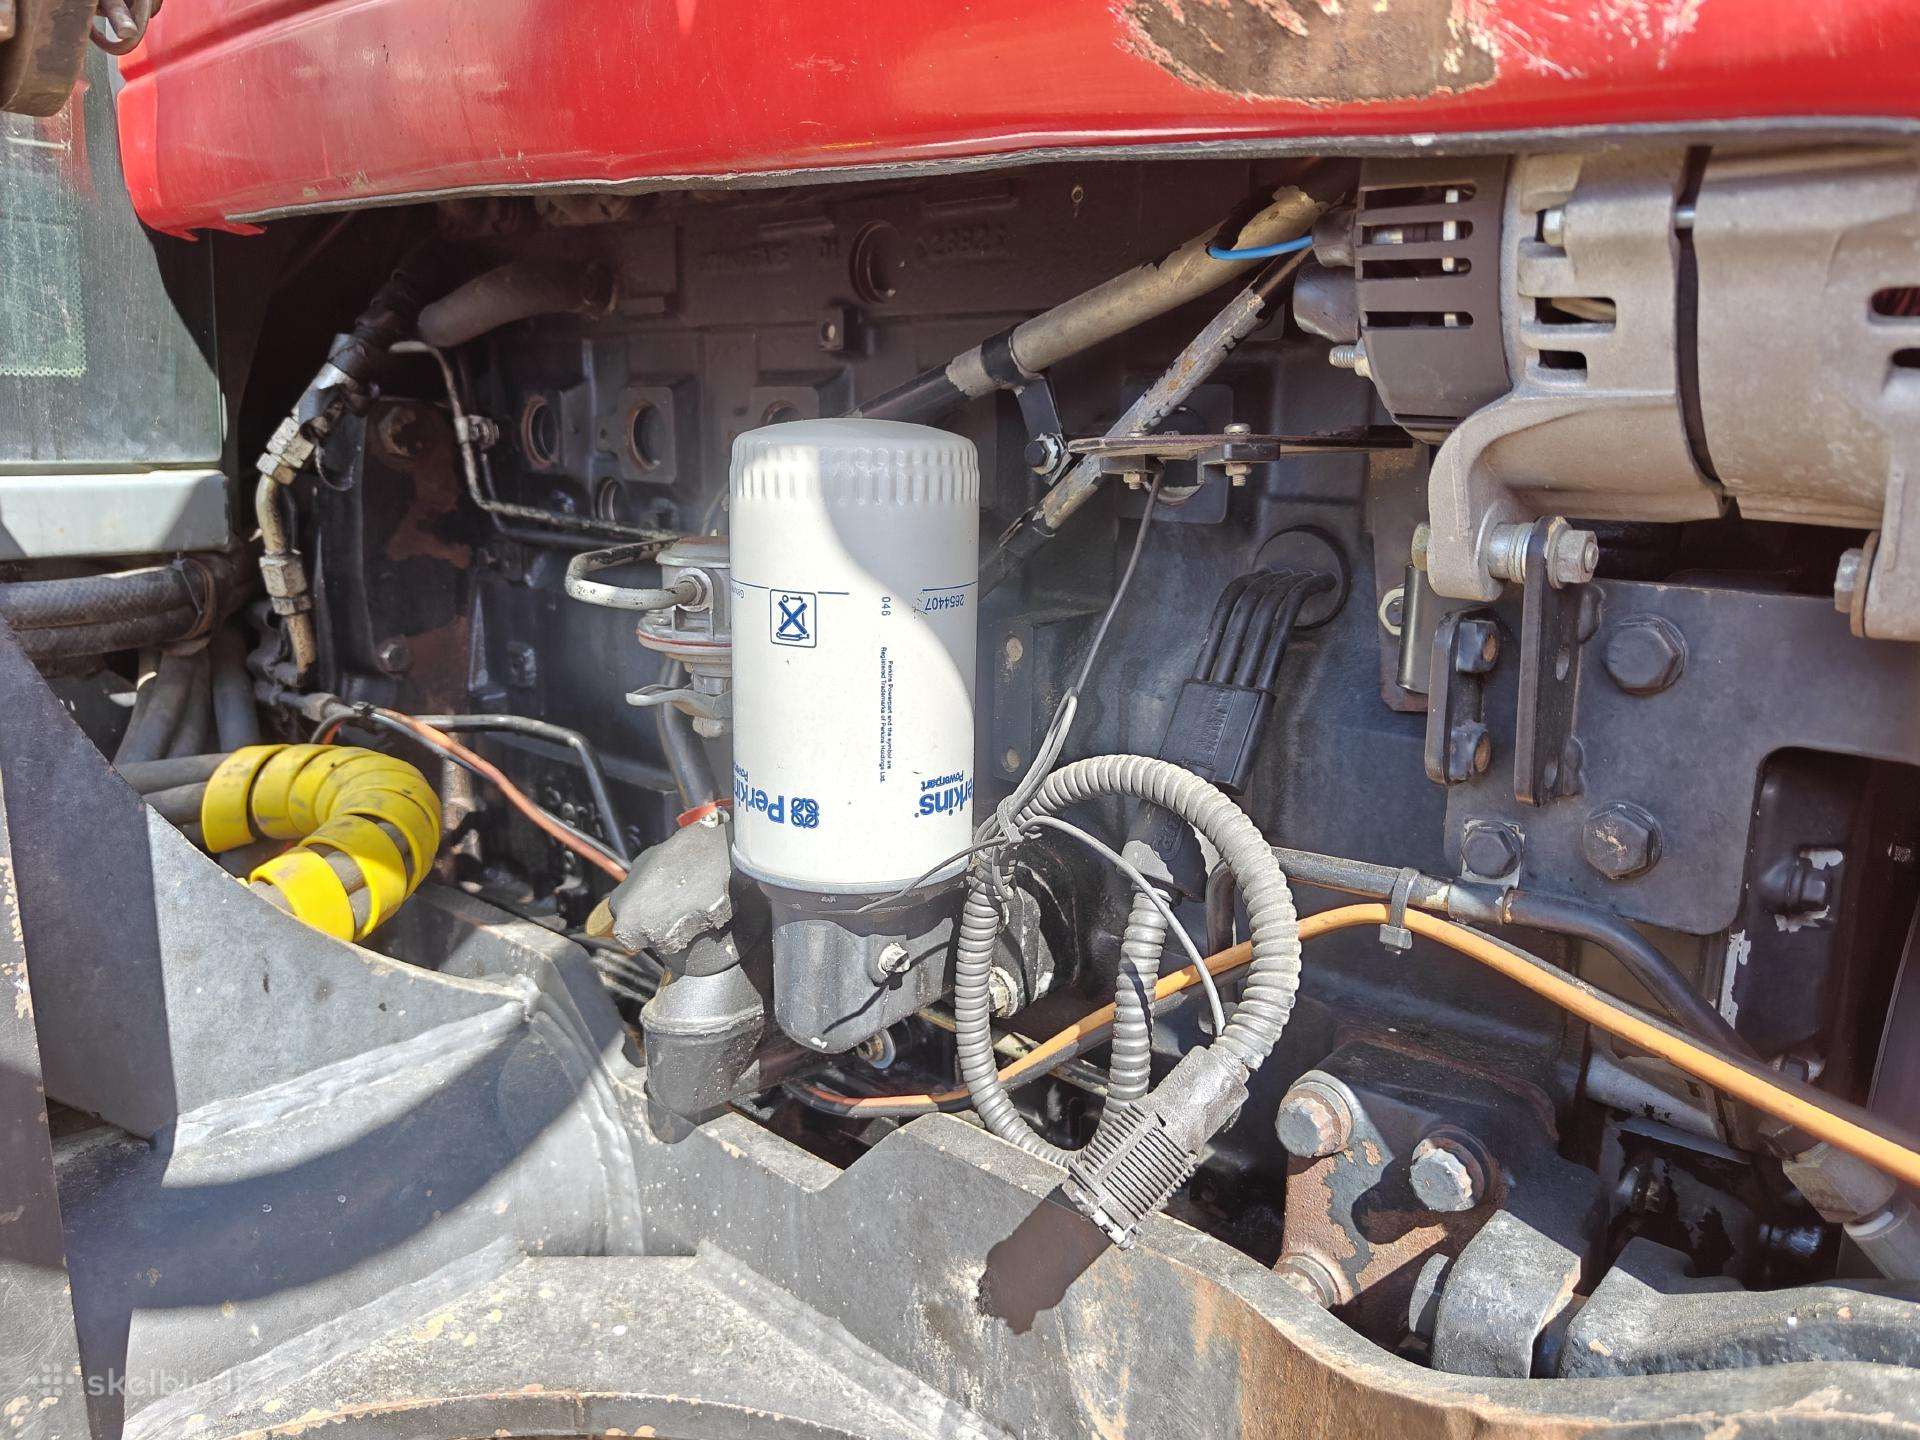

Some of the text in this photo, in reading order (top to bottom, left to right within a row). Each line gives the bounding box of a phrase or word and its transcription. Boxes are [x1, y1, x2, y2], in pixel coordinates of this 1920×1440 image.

[880, 596, 891, 617] 046
[924, 593, 965, 611] 2654407
[920, 769, 964, 792] Powerpart
[734, 778, 785, 824] Perkin
[919, 777, 973, 816] erkins
